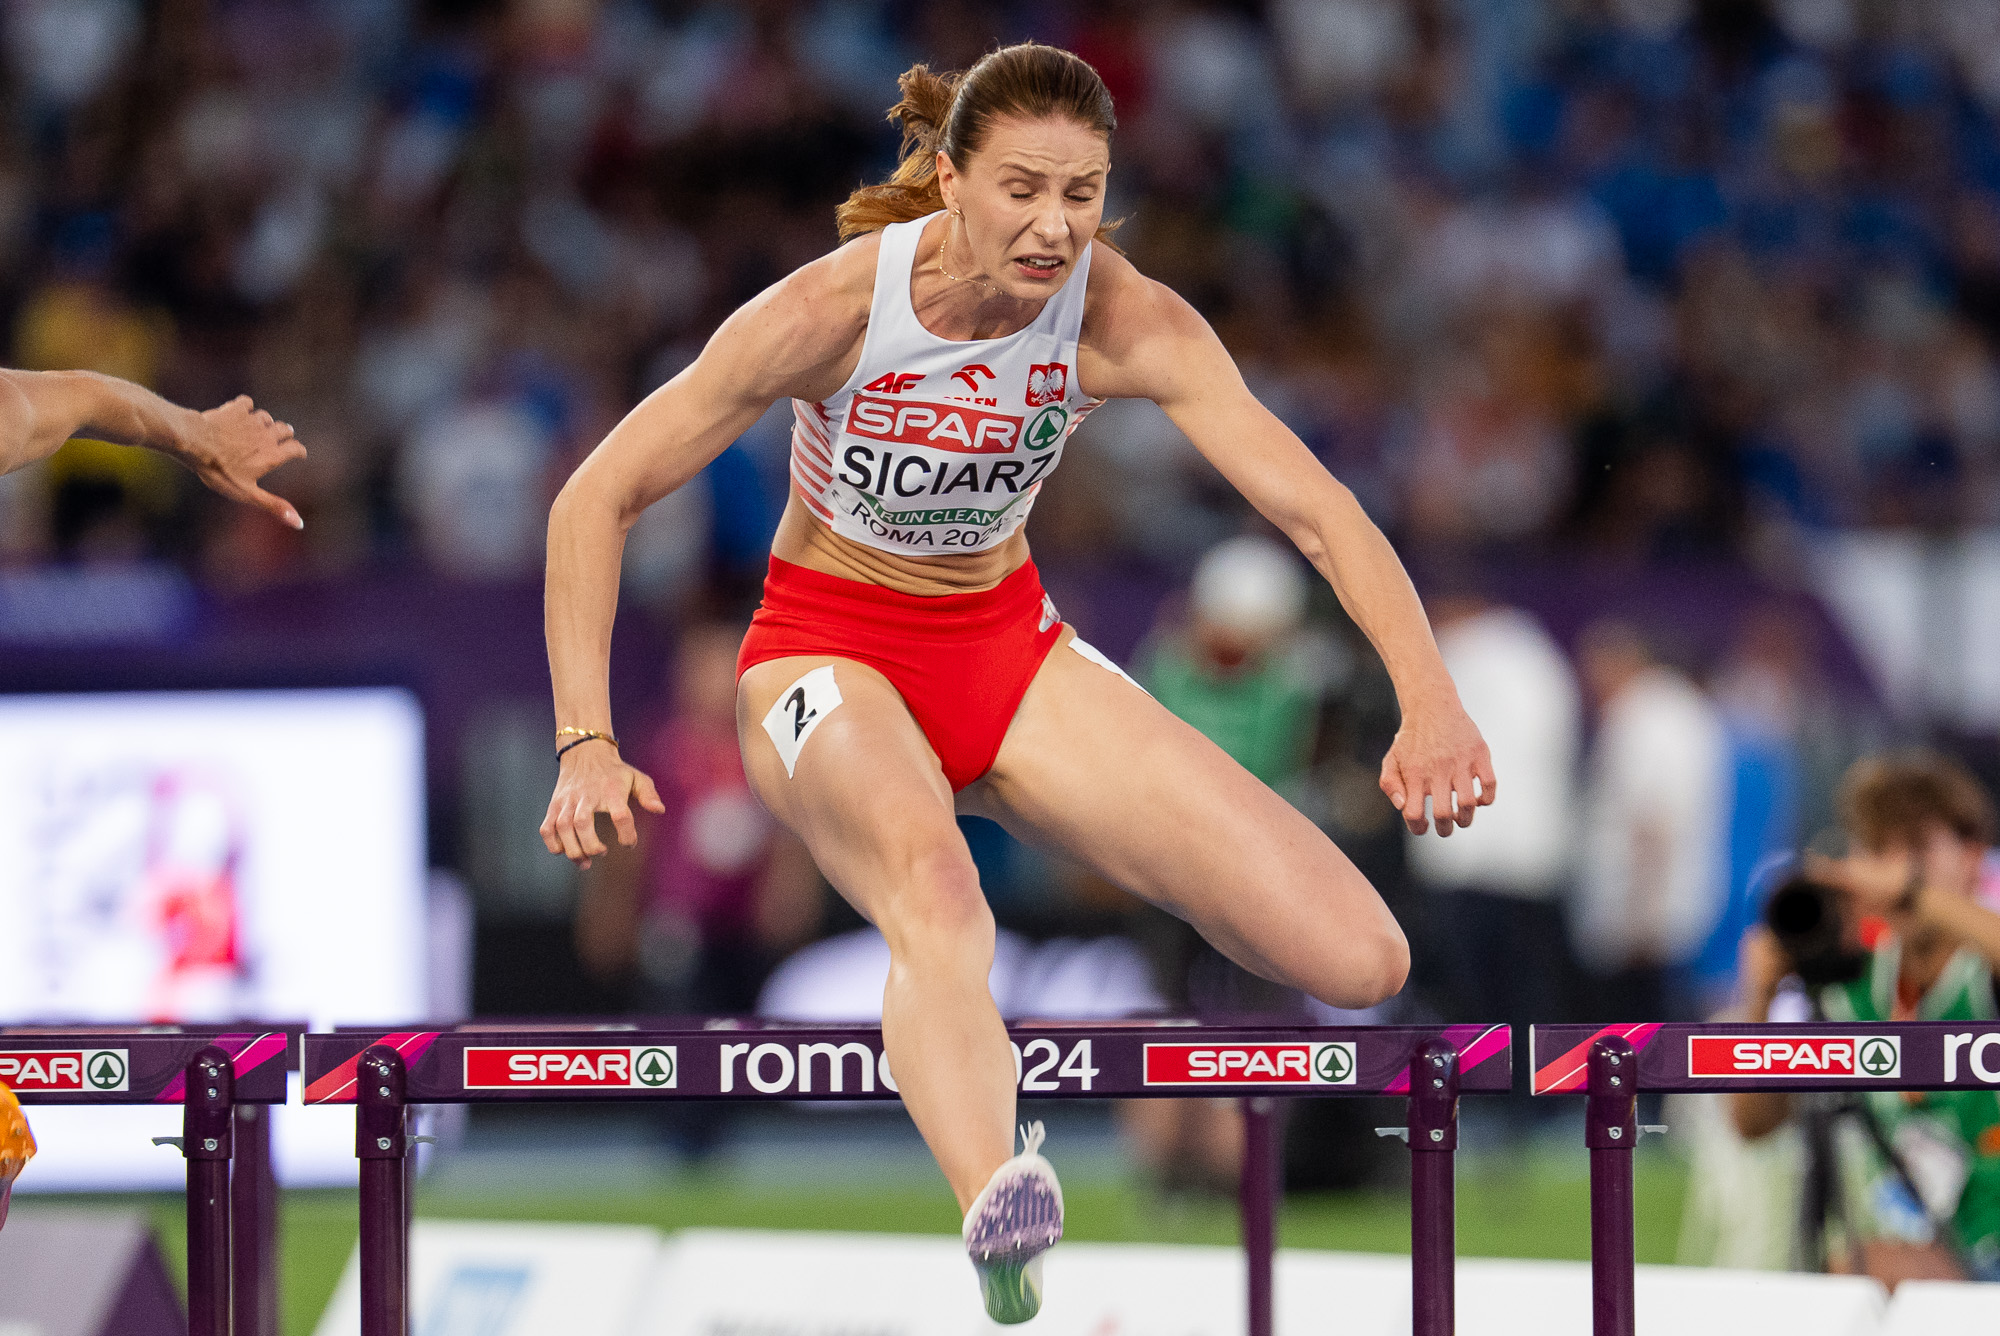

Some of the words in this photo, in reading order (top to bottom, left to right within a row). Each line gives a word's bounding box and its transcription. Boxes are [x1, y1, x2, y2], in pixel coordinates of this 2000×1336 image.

[854, 403, 1017, 448] SPAR
[838, 445, 1056, 497] SICIARZ
[851, 502, 934, 546] ROMA
[942, 518, 1004, 547] 2024
[880, 511, 924, 524] RUN
[929, 509, 997, 525] CLEAN
[784, 686, 818, 742] 2
[508, 1054, 628, 1081] SPAR
[1010, 1038, 1100, 1091] 24
[1188, 1050, 1307, 1078] SPAR
[1733, 1043, 1852, 1070] SPAR
